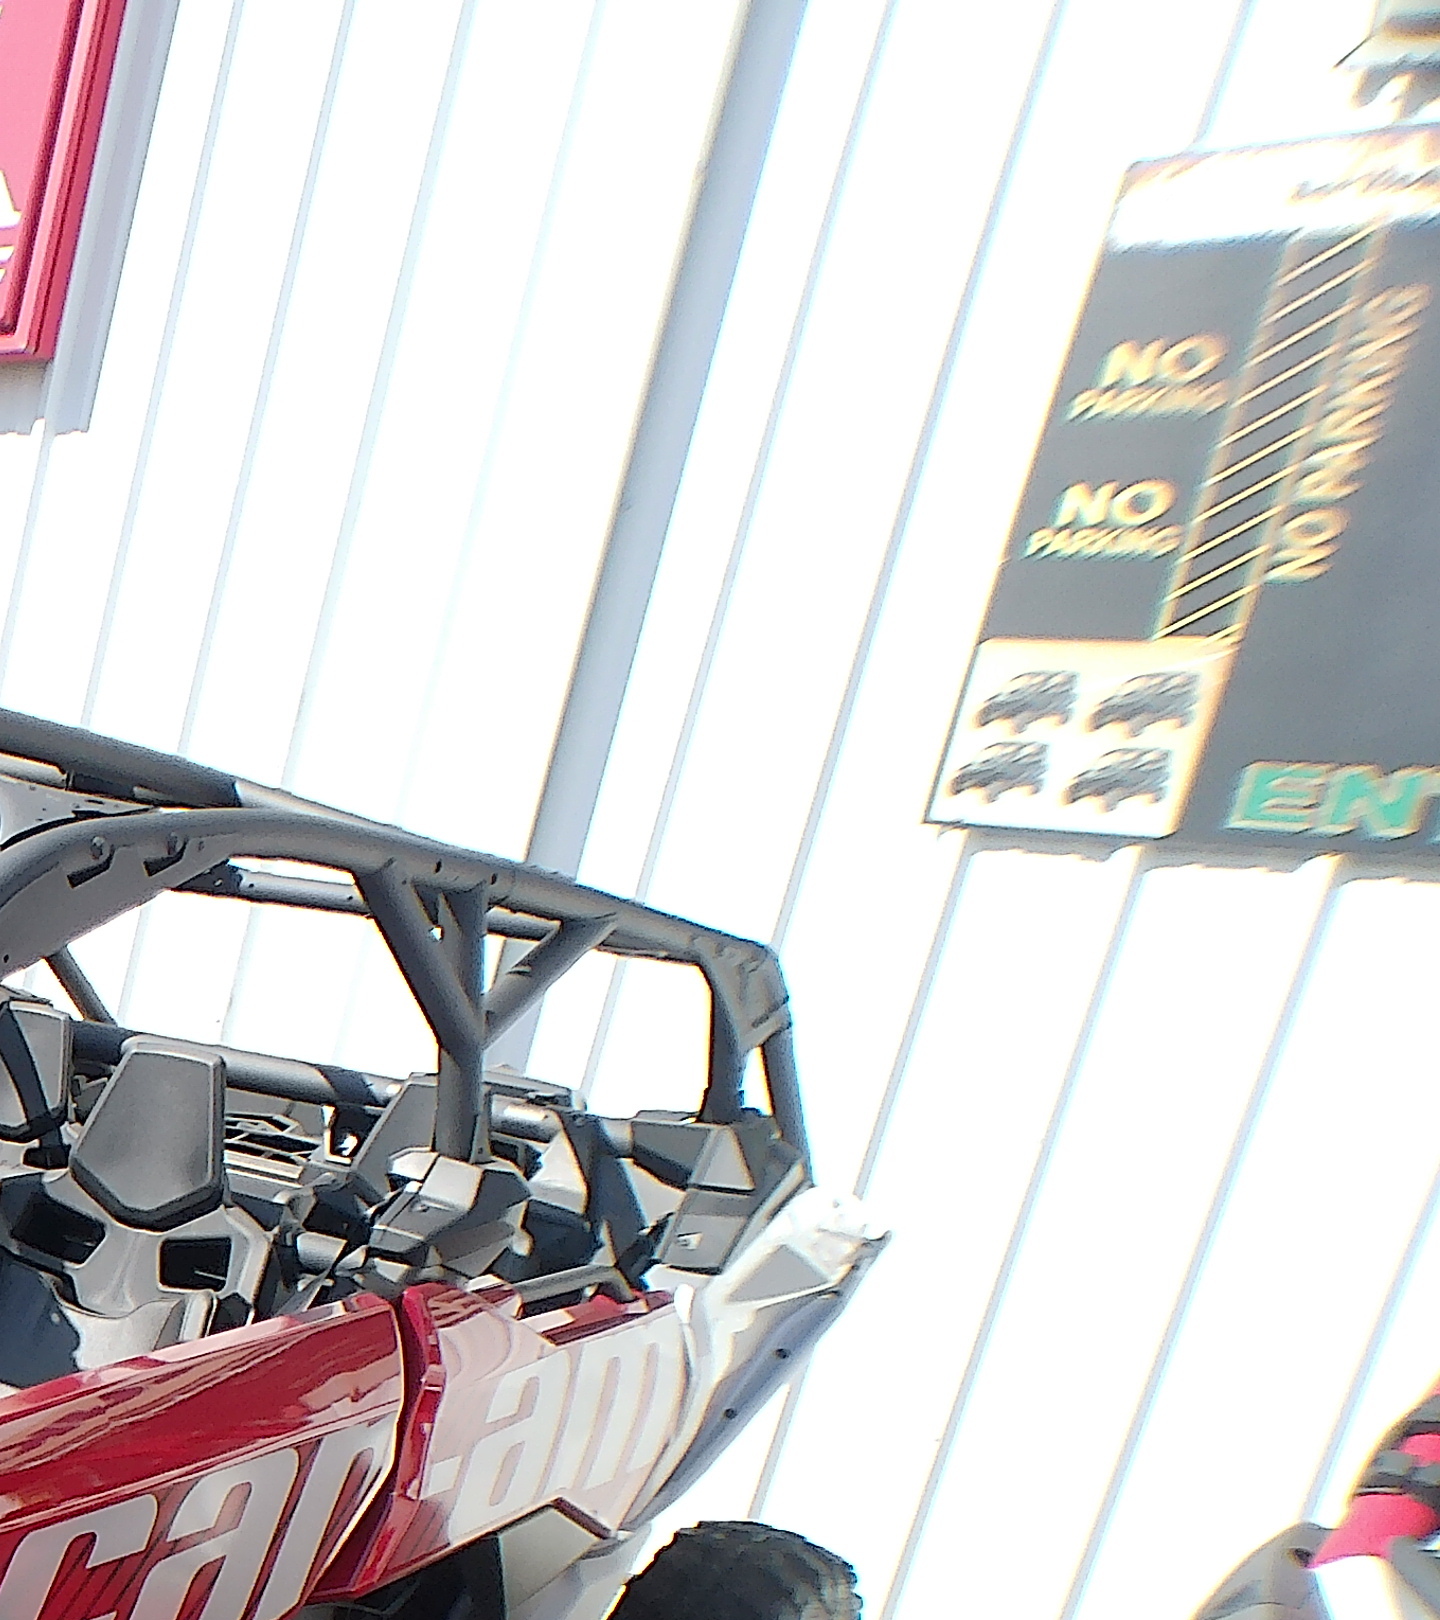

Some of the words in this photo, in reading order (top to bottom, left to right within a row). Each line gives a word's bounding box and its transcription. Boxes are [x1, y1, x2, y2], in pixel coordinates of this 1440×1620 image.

[1092, 333, 1227, 387] NO
[1052, 477, 1179, 528] NO
[1222, 759, 1440, 842] EN
